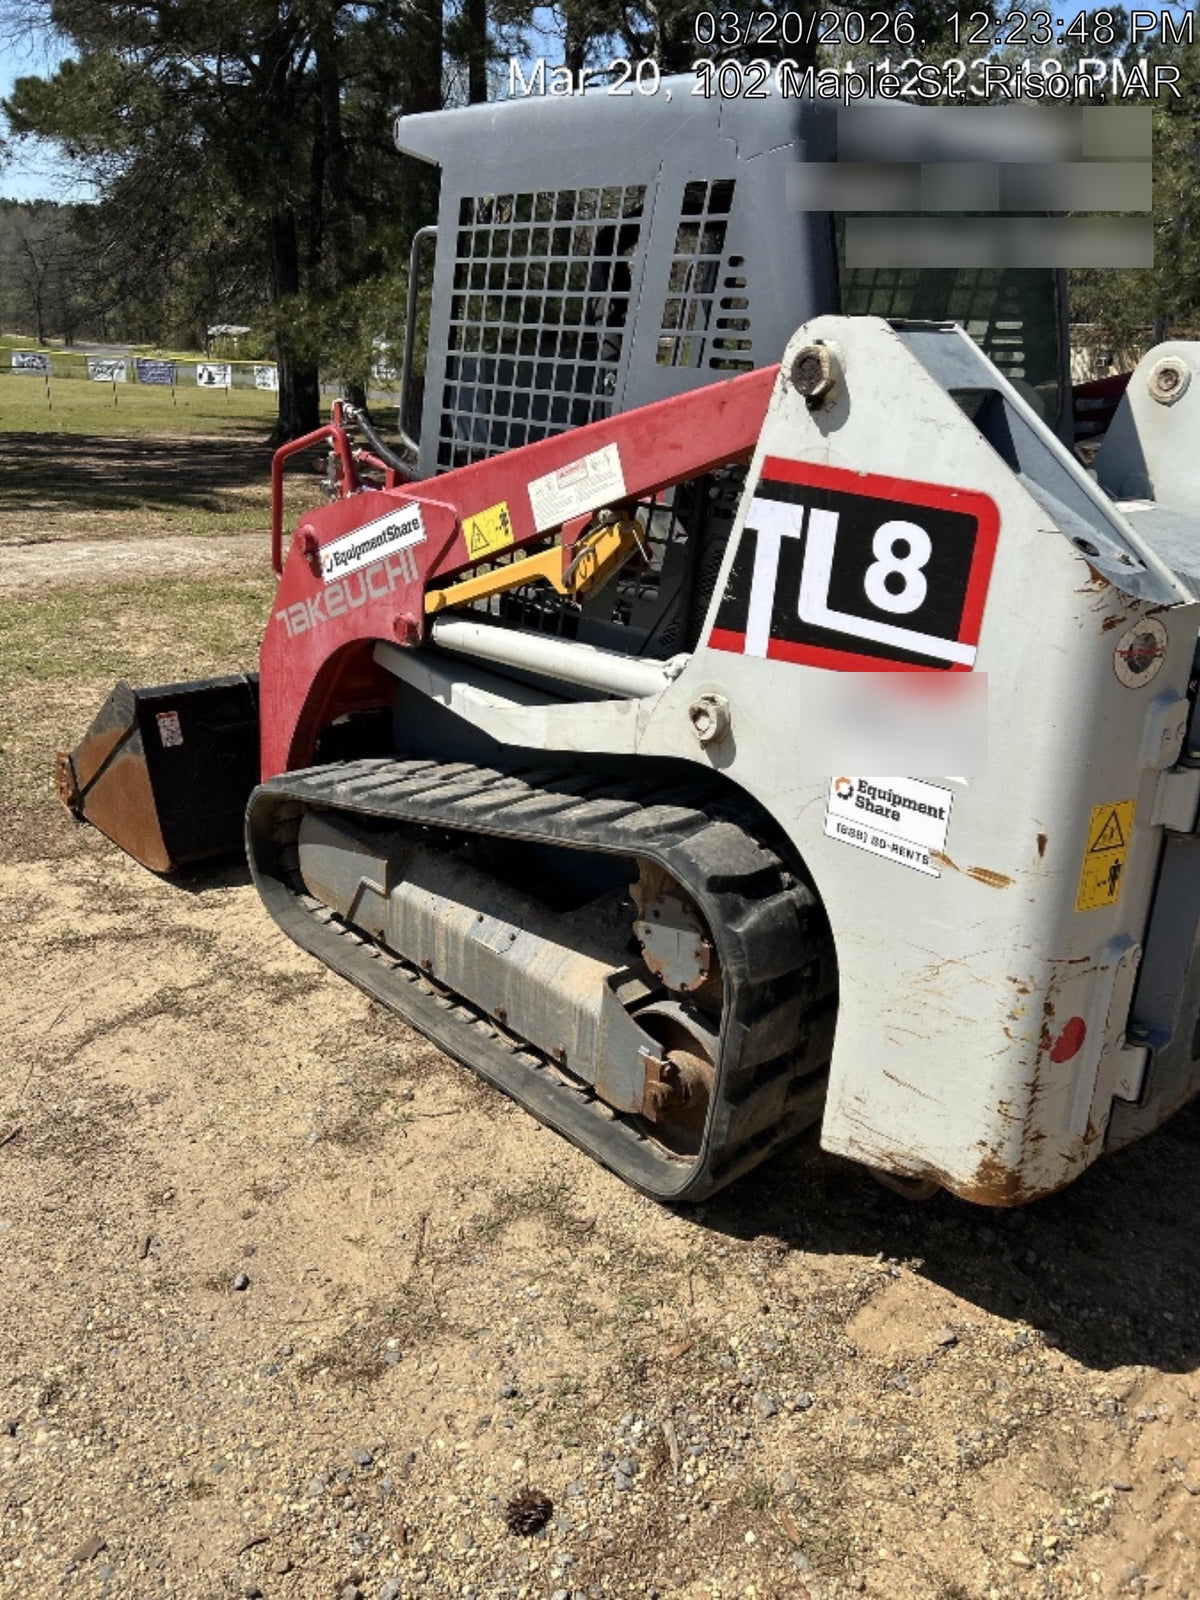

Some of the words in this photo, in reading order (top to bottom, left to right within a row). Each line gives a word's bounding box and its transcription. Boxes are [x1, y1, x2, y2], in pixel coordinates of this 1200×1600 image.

[333, 517, 420, 568] EquipmentShare
[743, 497, 977, 666] TL8
[855, 794, 900, 822] Share
[857, 778, 946, 821] Equipment
